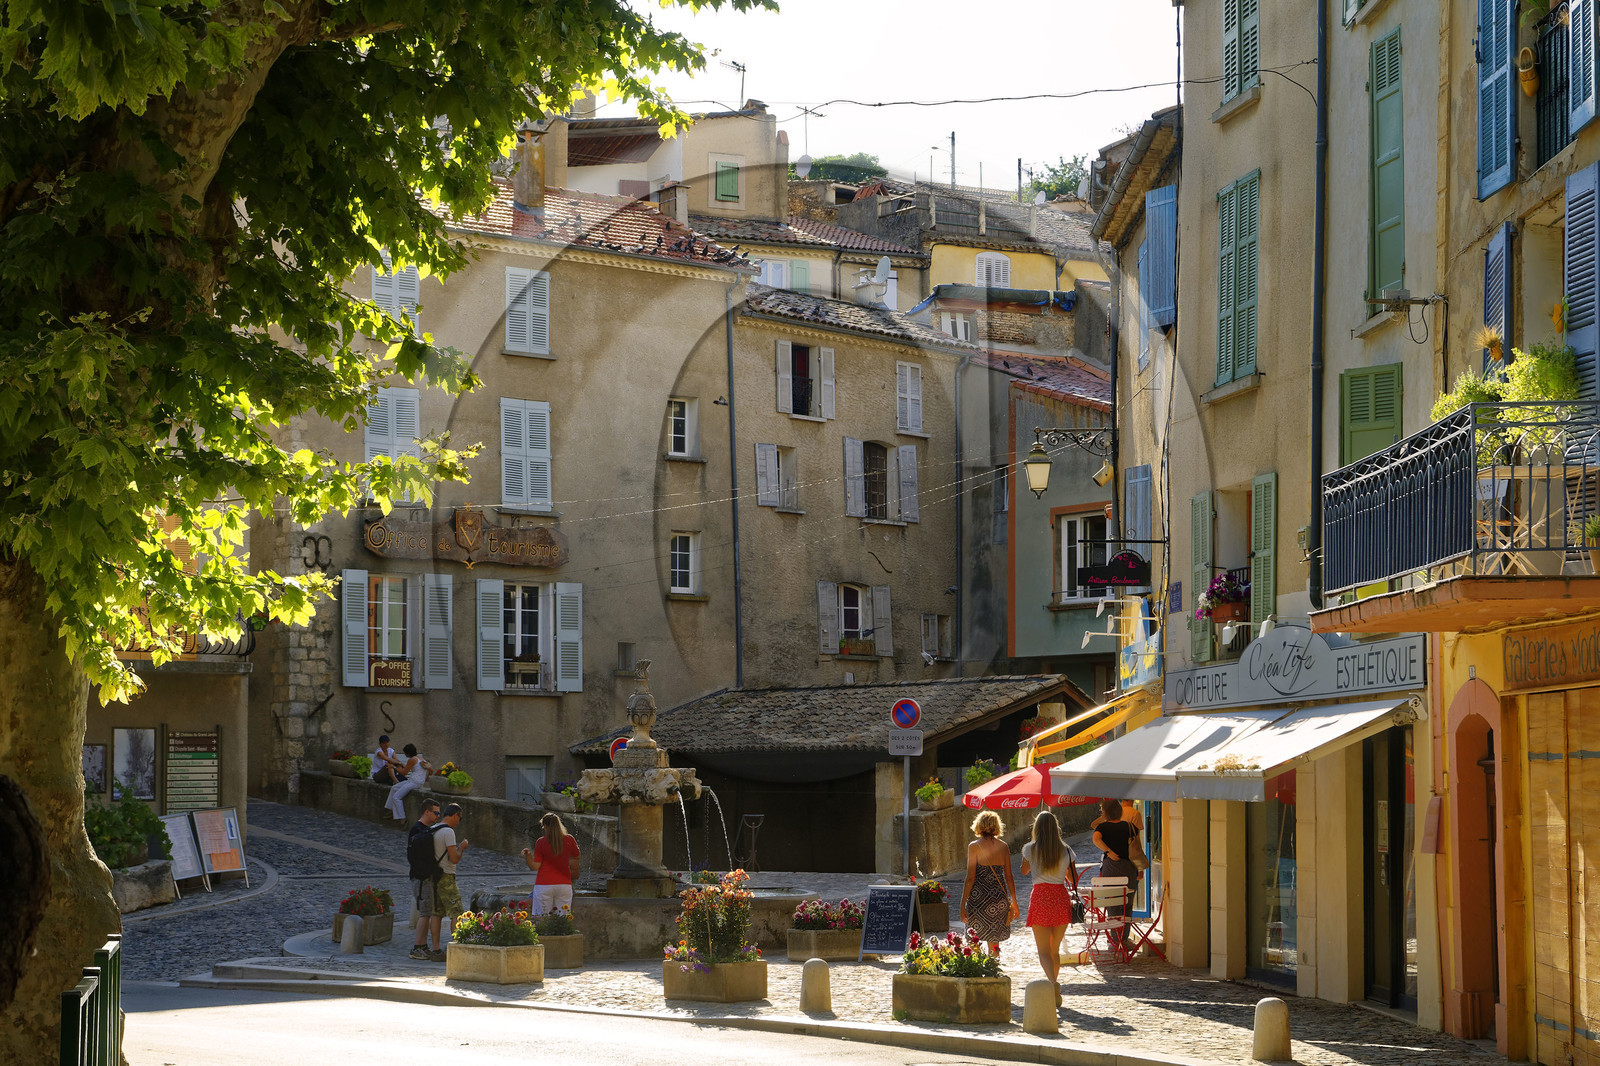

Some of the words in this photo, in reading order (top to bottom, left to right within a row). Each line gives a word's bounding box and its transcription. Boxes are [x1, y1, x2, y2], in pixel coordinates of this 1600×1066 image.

[367, 522, 428, 550] Office
[437, 537, 452, 551] de
[487, 532, 560, 558] tourisme
[388, 661, 411, 670] OFFICE
[1336, 645, 1417, 689] ESTHÉTIQUE
[1503, 635, 1568, 683] Galeries
[377, 678, 411, 687] TOURISME
[401, 670, 411, 679] DE
[1175, 672, 1227, 706] COIFFURE
[1001, 797, 1030, 808] Coca-Cola
